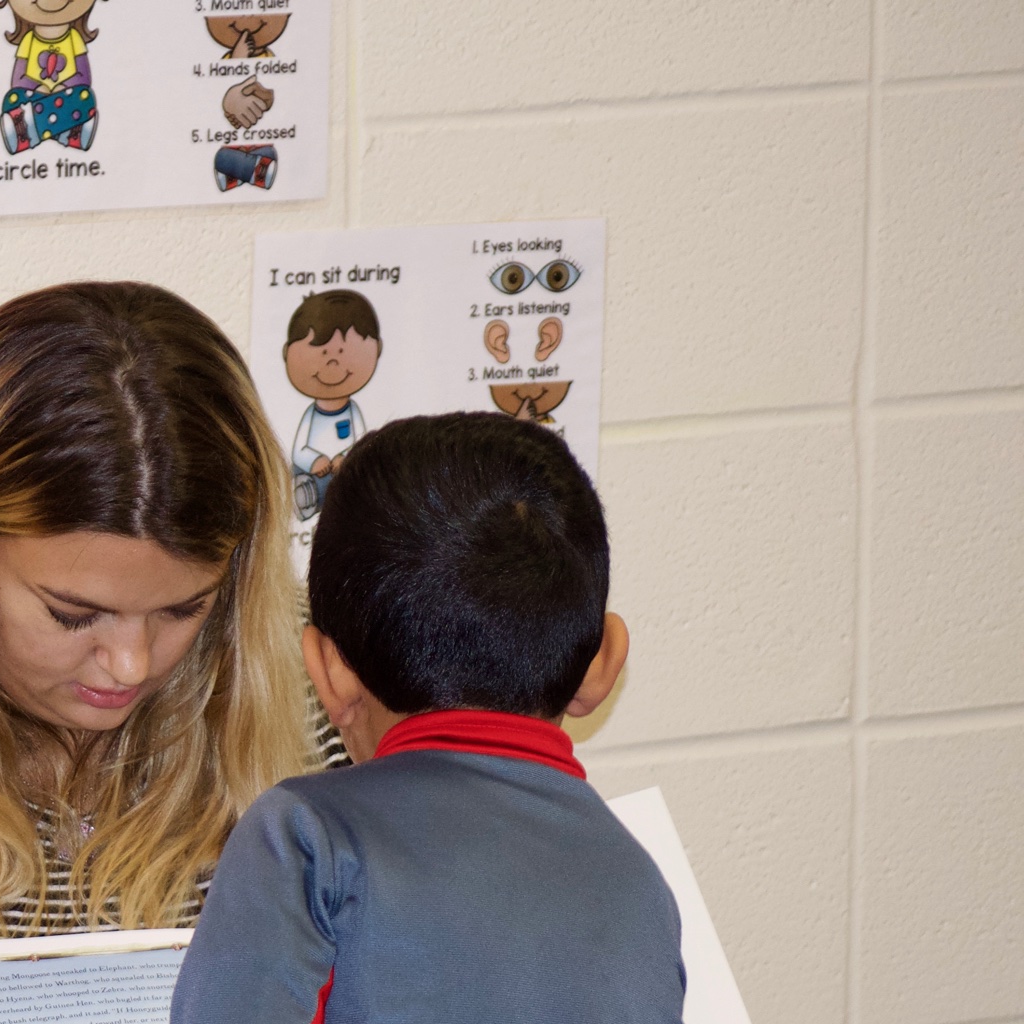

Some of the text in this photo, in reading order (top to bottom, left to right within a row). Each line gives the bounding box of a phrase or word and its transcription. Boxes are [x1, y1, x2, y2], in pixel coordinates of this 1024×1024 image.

[193, 59, 297, 77] 4. Hands folded
[191, 125, 296, 144] 5. Legs crossed
[56, 158, 105, 178] time.
[483, 240, 513, 255] Eyes
[517, 238, 563, 253] looking
[270, 264, 401, 287] I can sit during
[470, 301, 571, 318] 2. Ears listening
[468, 364, 560, 381] 3. Mouth quiet
[12, 972, 50, 980] Mongoose
[52, 967, 87, 977] squeaked
[9, 983, 42, 991] bellowed
[55, 978, 91, 987] Warthog,
[112, 974, 144, 982] squealed
[56, 989, 89, 998] whooped
[29, 1014, 67, 1022] telegraph,
